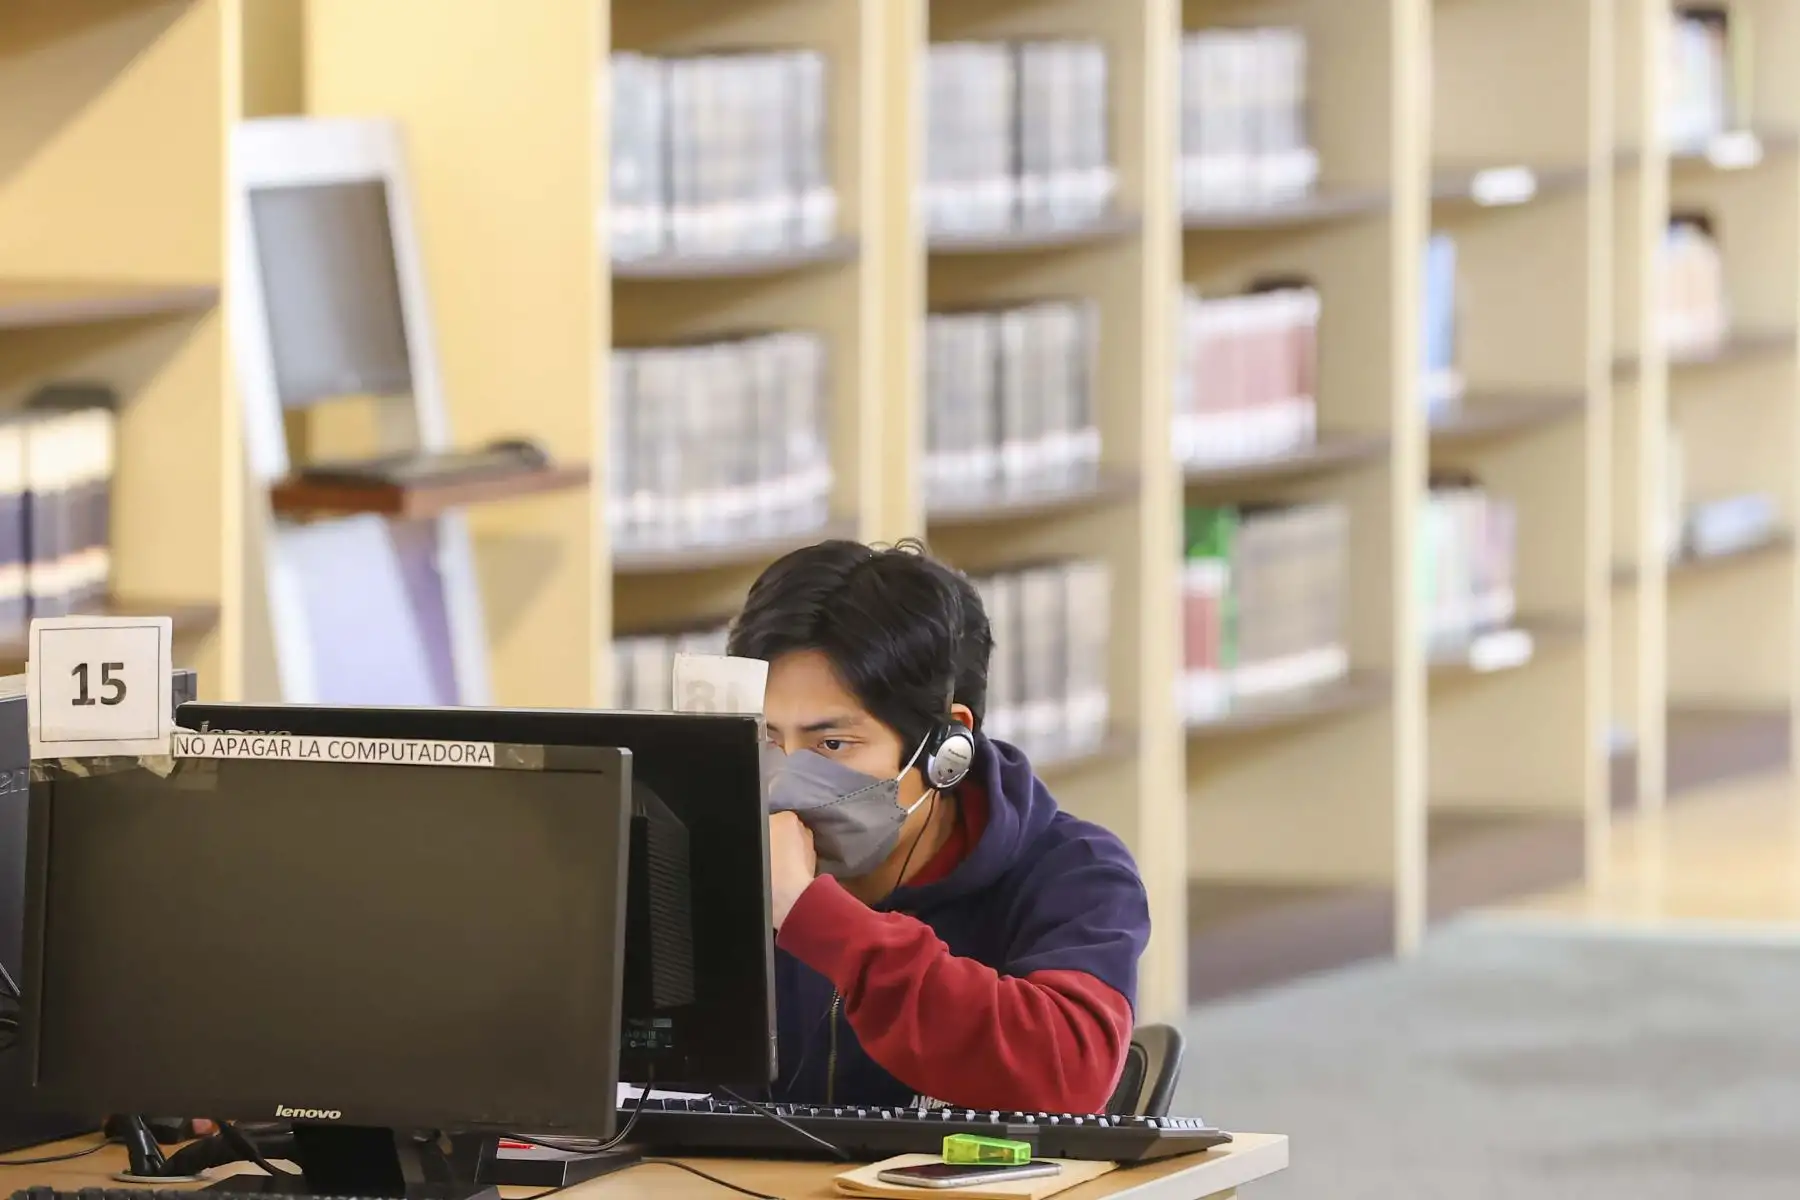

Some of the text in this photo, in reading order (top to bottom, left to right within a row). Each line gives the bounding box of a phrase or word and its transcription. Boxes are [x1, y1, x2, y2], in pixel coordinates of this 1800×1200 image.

[71, 662, 127, 706] 15
[176, 736, 492, 763] NO APAGAR LA COMPUTADORA
[275, 1104, 342, 1120] lenovo
